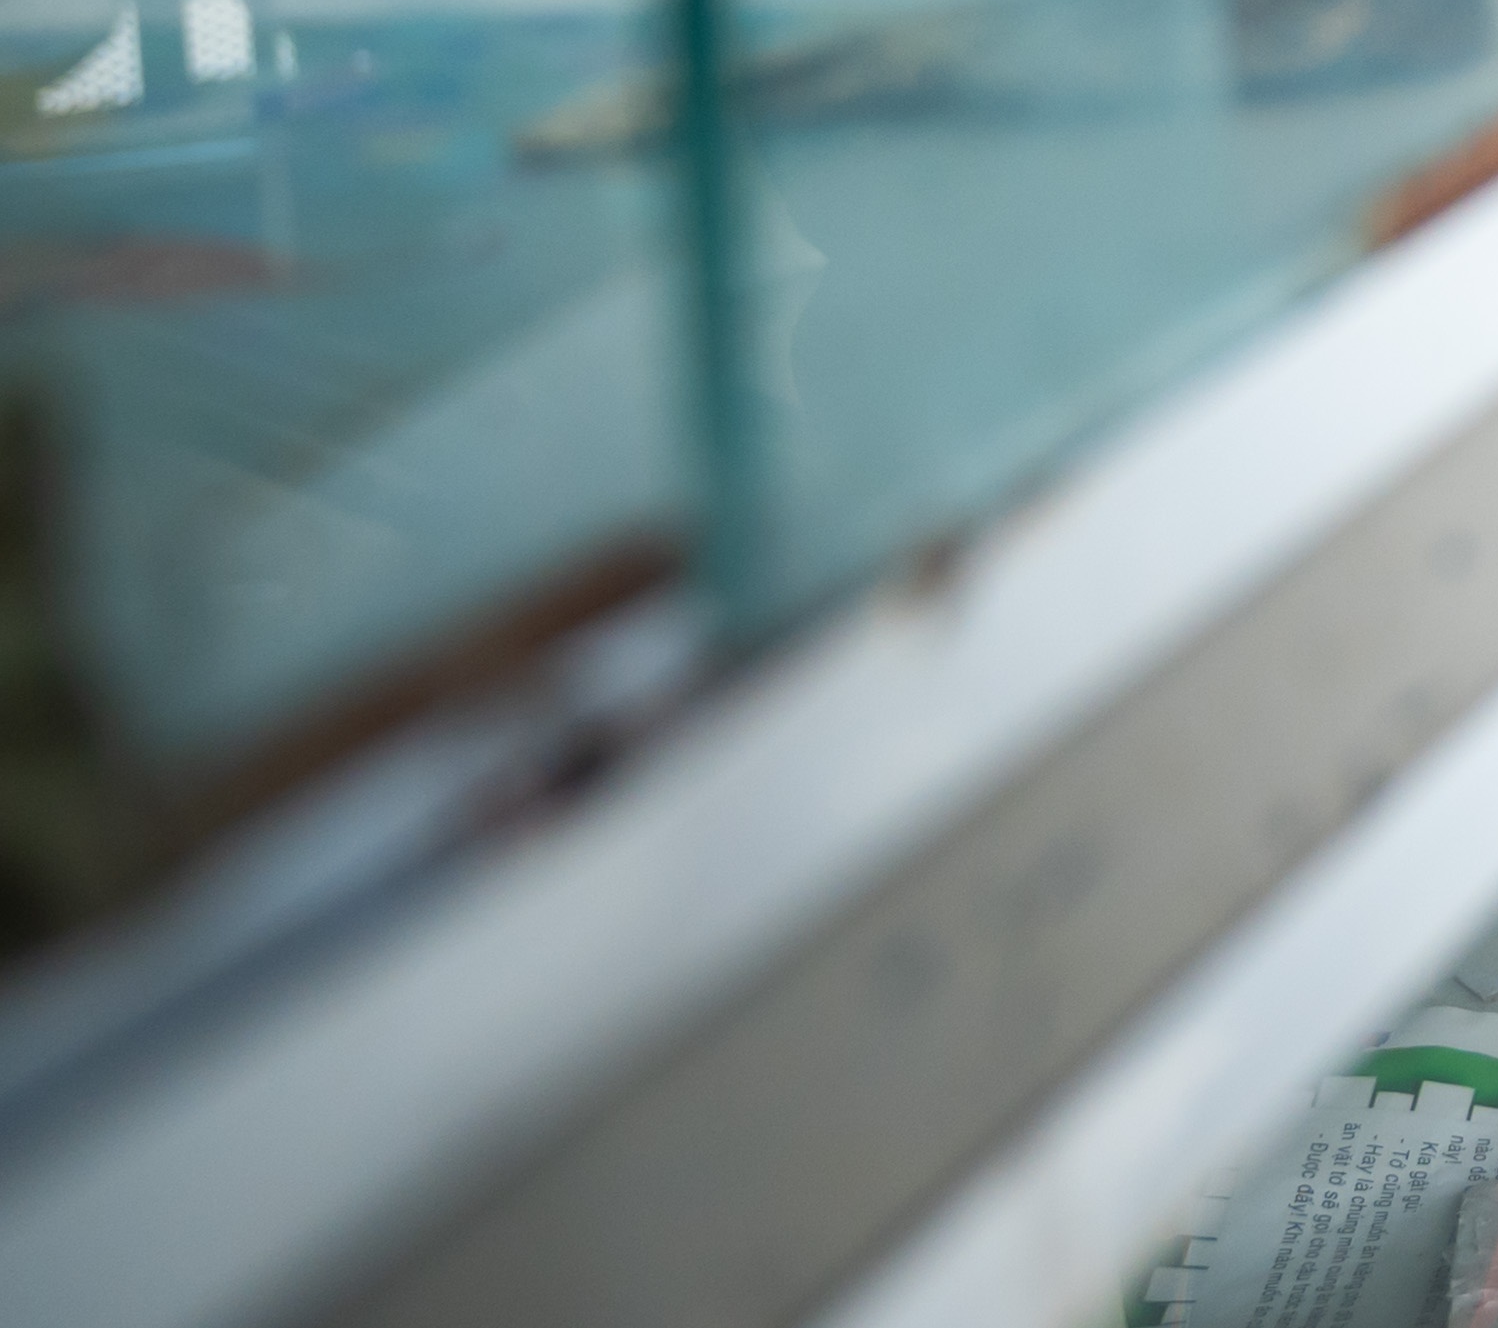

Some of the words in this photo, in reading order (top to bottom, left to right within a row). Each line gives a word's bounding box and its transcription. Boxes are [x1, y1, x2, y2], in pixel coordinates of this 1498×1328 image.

[1341, 1122, 1362, 1141] ăn
[1301, 1142, 1329, 1180] Được
[1332, 1146, 1352, 1167] vặt
[1356, 1143, 1384, 1175] Hay
[1443, 1135, 1466, 1165] này!
[1473, 1138, 1491, 1162] nào
[1354, 1177, 1374, 1192] là
[1373, 1173, 1400, 1208] cũng
[1321, 1190, 1339, 1210] sẽ
[1281, 1220, 1306, 1245] Khi
